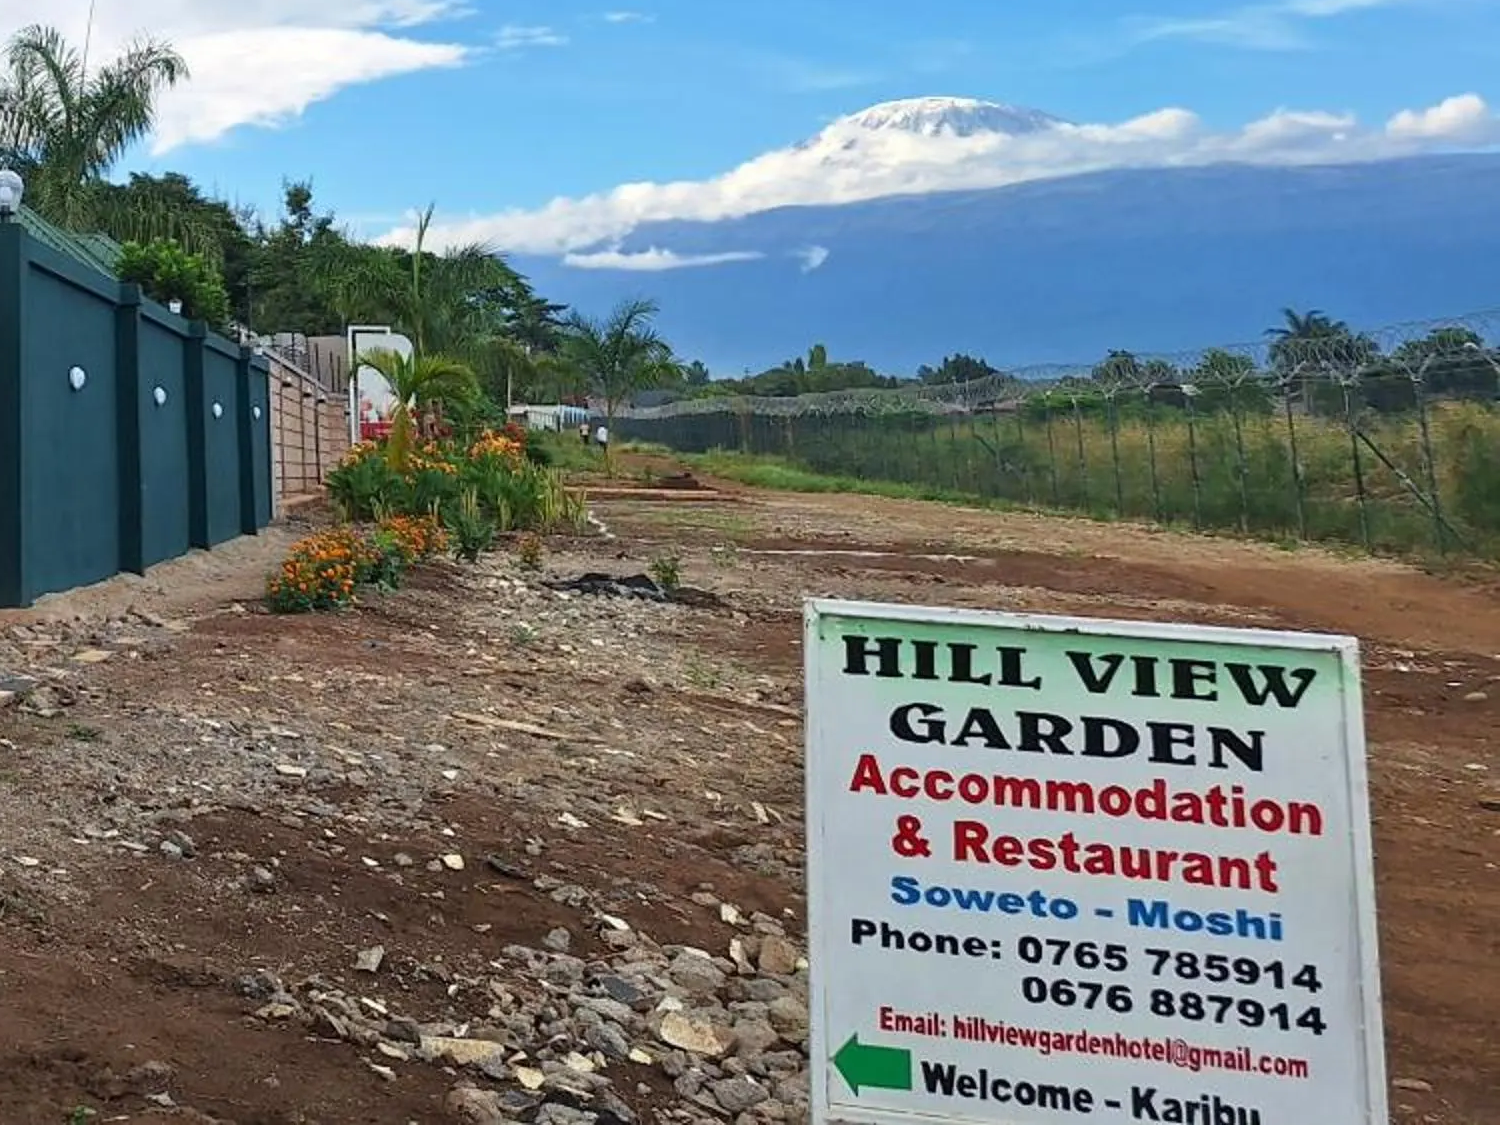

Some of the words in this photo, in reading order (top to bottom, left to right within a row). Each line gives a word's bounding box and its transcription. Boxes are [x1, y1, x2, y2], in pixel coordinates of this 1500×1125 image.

[842, 634, 1043, 690] HILL
[1065, 650, 1317, 709] VIEW
[890, 703, 1265, 771] GARDEN
[850, 754, 1322, 835] Accommodation
[892, 816, 931, 858] &
[954, 820, 1278, 893] Restaurant
[891, 876, 1077, 920] Soweto
[1096, 908, 1113, 916] -
[1128, 899, 1282, 941] Moshi
[851, 919, 1001, 959] Phone:
[1017, 937, 1127, 972] 0765
[1145, 949, 1321, 993] 785914
[1022, 976, 1133, 1015] 0676
[1151, 991, 1327, 1035] 887914
[880, 1007, 946, 1036] Email:
[953, 1016, 1308, 1079] hillviewgardenhotel@gmail.com
[921, 1061, 1093, 1113] Welcome
[1106, 1101, 1120, 1109] -
